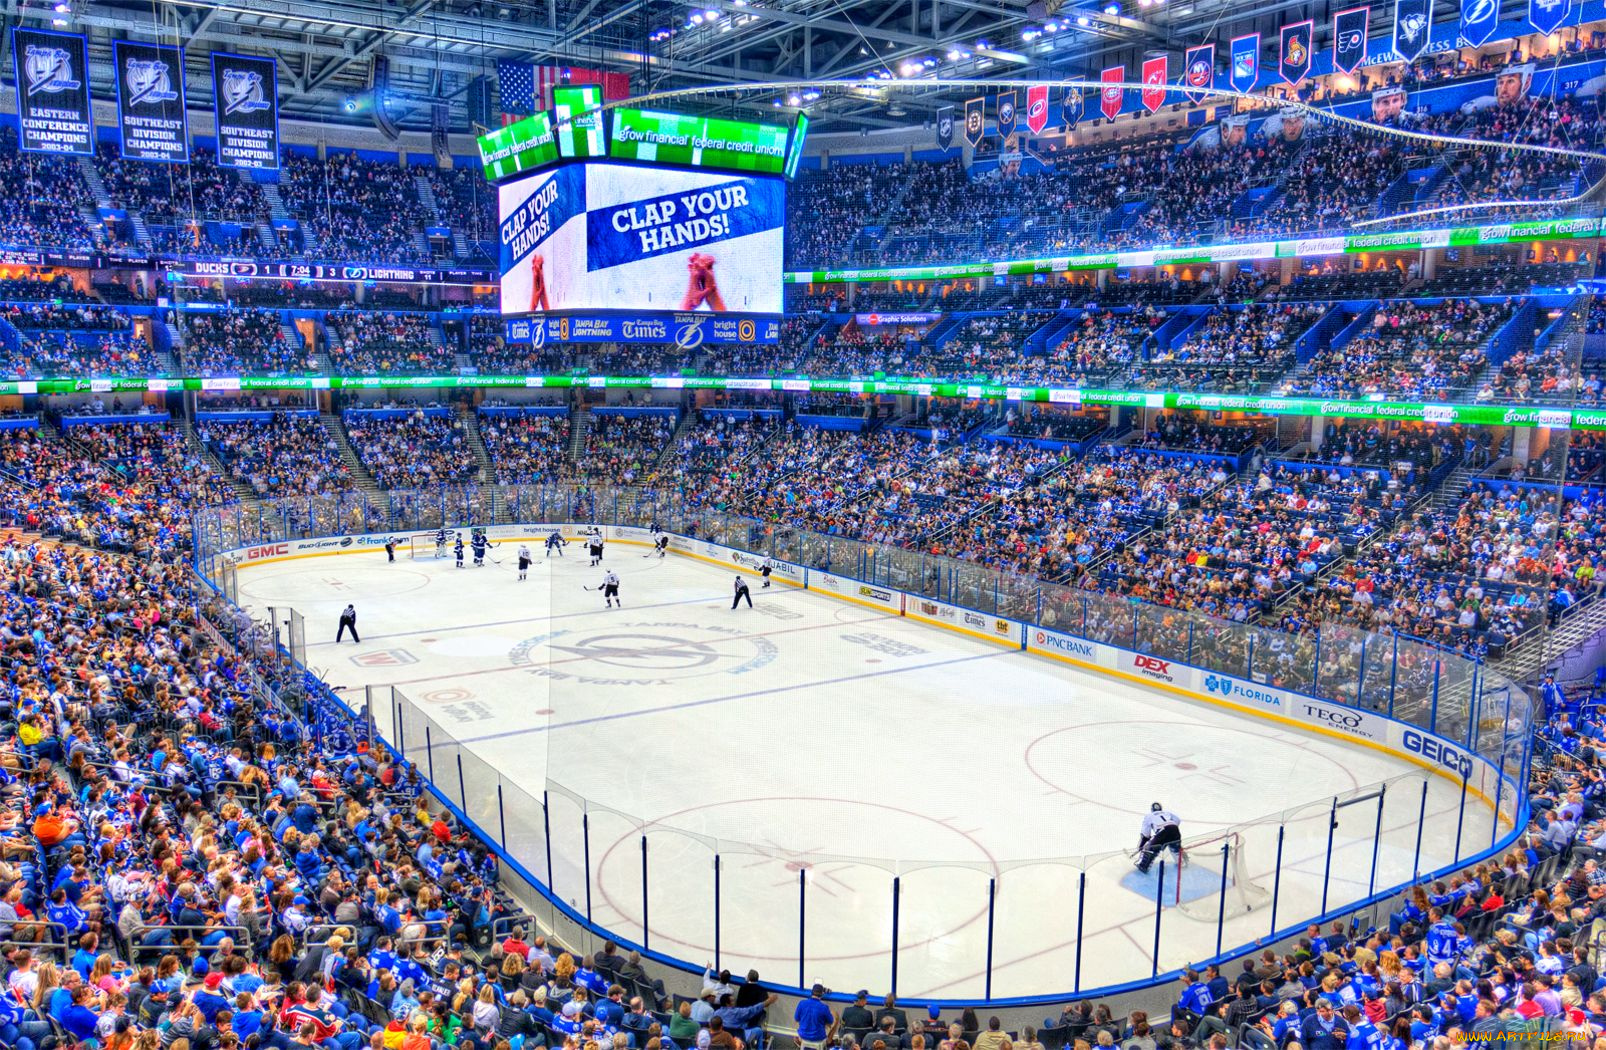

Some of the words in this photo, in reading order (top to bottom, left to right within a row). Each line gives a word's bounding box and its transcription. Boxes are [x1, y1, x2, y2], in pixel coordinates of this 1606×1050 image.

[1564, 79, 1579, 90] 317
[30, 107, 81, 121] EASTERN
[22, 118, 89, 133] CONFERENCE
[125, 116, 183, 129] SOUTHEAST
[27, 130, 87, 143] CHAMPIONS
[133, 128, 176, 141] DIVISION
[221, 126, 275, 139] SOUTHEAST
[127, 139, 183, 152] CHAMPIONS
[228, 138, 268, 149] DIVISION
[619, 127, 643, 142] grow
[645, 130, 688, 145] financial
[691, 136, 725, 150] federal
[726, 142, 753, 154] credit
[755, 145, 783, 156] union
[140, 151, 171, 160] 2003-04
[222, 148, 275, 160] CHAMPIONS
[501, 211, 528, 246] CLAP
[526, 180, 560, 222] YOUR
[613, 201, 674, 235] CLAP
[681, 185, 750, 219] YOUR
[640, 213, 730, 254] HANDS!
[1481, 226, 1507, 242] grow
[1508, 225, 1550, 240] financial
[1554, 221, 1593, 236] federal
[511, 219, 552, 262] HANDS!
[1352, 236, 1380, 249] federal
[1383, 234, 1408, 246] credit
[1409, 233, 1435, 245] union
[195, 262, 229, 274] DUCKS
[264, 263, 270, 274] 1
[290, 265, 311, 275] 7:04
[329, 267, 336, 277] 3
[368, 269, 415, 280] LIGHTNING
[574, 320, 594, 329] TAMPA
[595, 319, 609, 329] BAY
[714, 321, 736, 330] bright
[878, 315, 899, 325] Graphic
[901, 313, 928, 323] Solutions
[572, 328, 612, 337] LIGHTNING
[622, 321, 666, 338] Times
[120, 380, 143, 390] federal
[249, 378, 271, 387] federal
[1088, 391, 1107, 401] federal
[1126, 393, 1141, 403] union
[1176, 397, 1194, 409] grow
[1222, 397, 1245, 408] federal
[1246, 399, 1265, 410] credit
[1266, 400, 1286, 410] union
[1321, 401, 1341, 413] grow
[1341, 402, 1374, 415] financial
[1376, 403, 1405, 417] federal
[1407, 406, 1430, 418] credit
[1504, 409, 1528, 423] grow
[1530, 411, 1572, 426] financial
[523, 527, 541, 535] bright
[542, 526, 561, 534] house
[247, 543, 289, 560] GMC
[298, 541, 316, 550] BUD
[317, 540, 340, 549] LIGHT
[772, 560, 796, 574] JABIL
[964, 612, 986, 628] Times
[997, 619, 1009, 632] tbt
[1047, 635, 1067, 651] PNC
[1067, 640, 1093, 657] BANK
[1133, 654, 1171, 675] DEX
[1141, 669, 1174, 683] imaging
[1233, 685, 1281, 707] FLORIDA
[1303, 703, 1363, 729] TECO
[1327, 721, 1374, 740] ENERGY
[1402, 730, 1474, 780] GEICO
